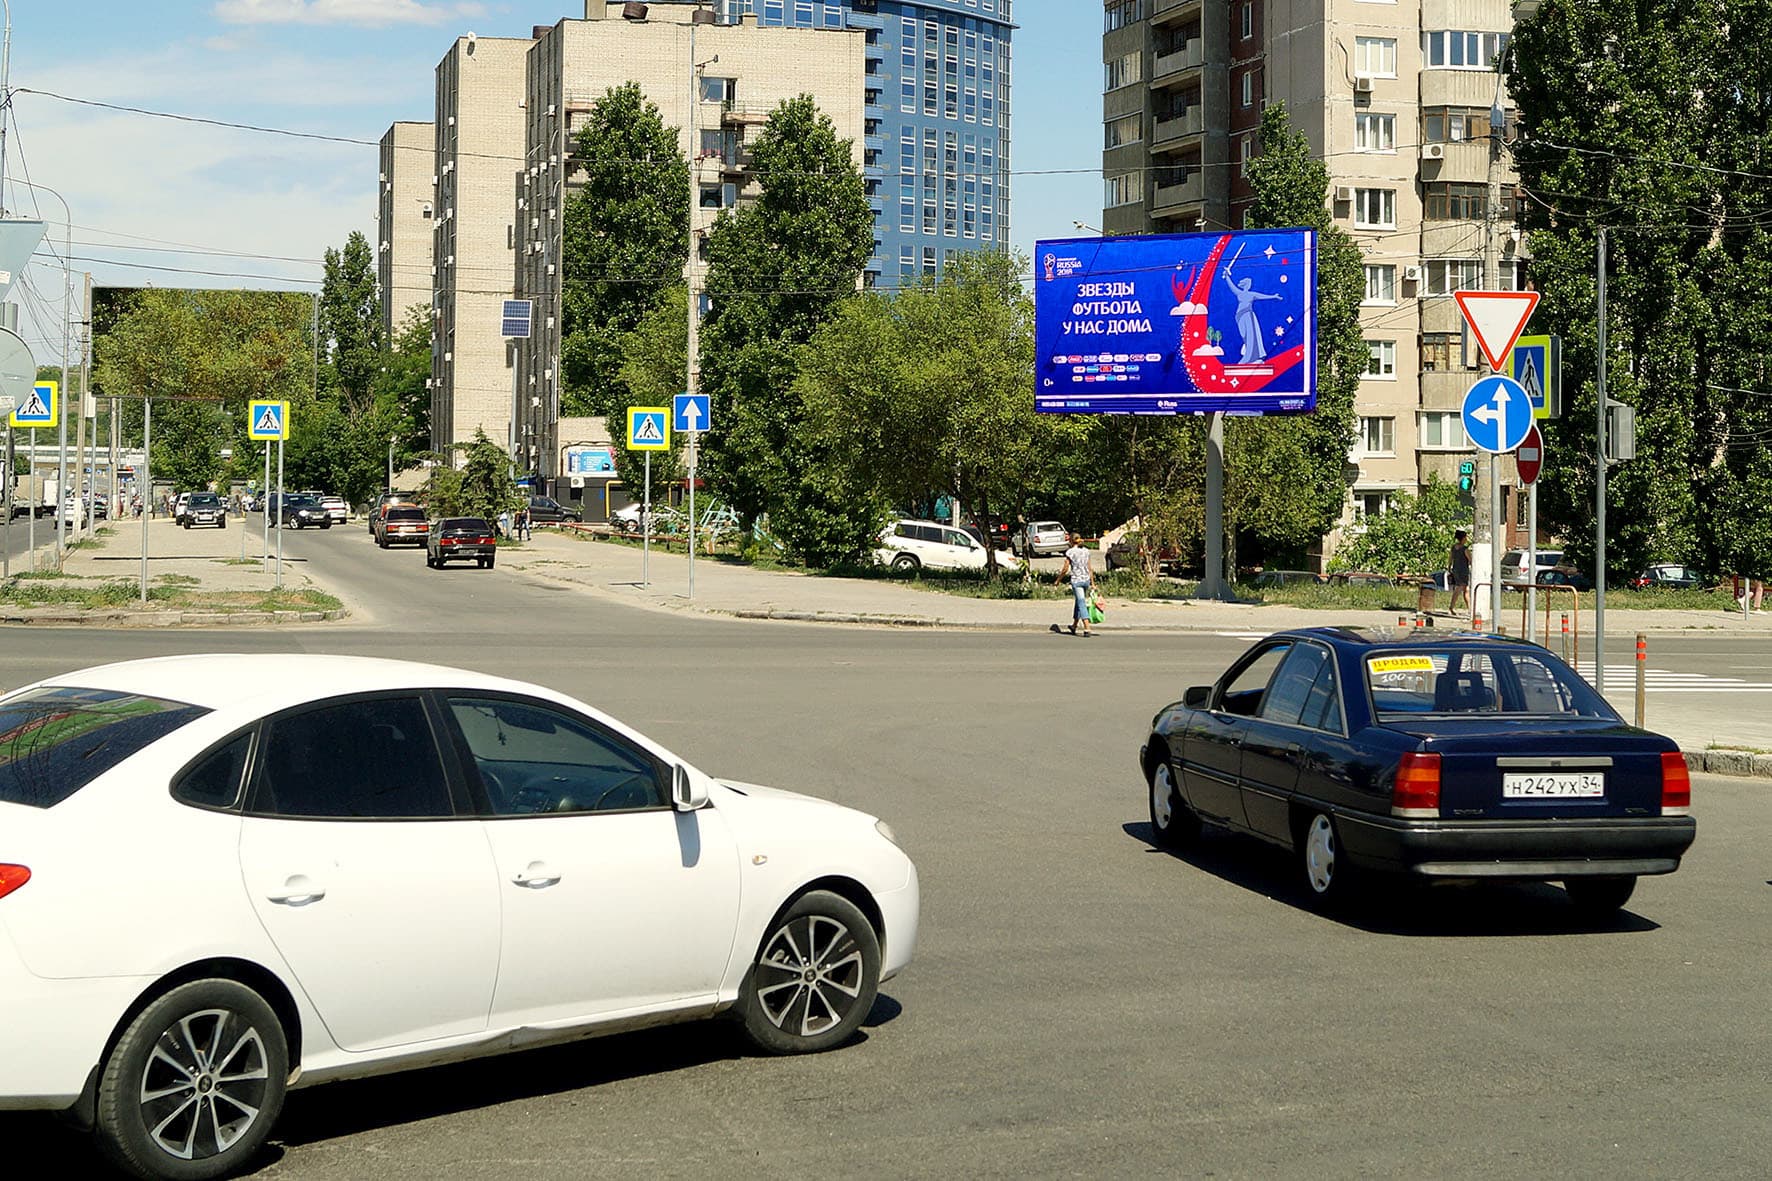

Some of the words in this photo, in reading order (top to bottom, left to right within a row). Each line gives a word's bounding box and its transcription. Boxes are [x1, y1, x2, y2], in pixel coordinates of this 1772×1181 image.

[1056, 260, 1082, 268] RUSSIA
[1077, 282, 1135, 298] ЗВЕЗДЫ
[1072, 300, 1142, 316] ФУТБОЛА
[1062, 321, 1072, 335] У
[1074, 320, 1105, 335] НАС
[1106, 319, 1152, 336] ДОМА
[1372, 658, 1430, 668] ПРОДАЮ
[1582, 776, 1599, 790] 34
